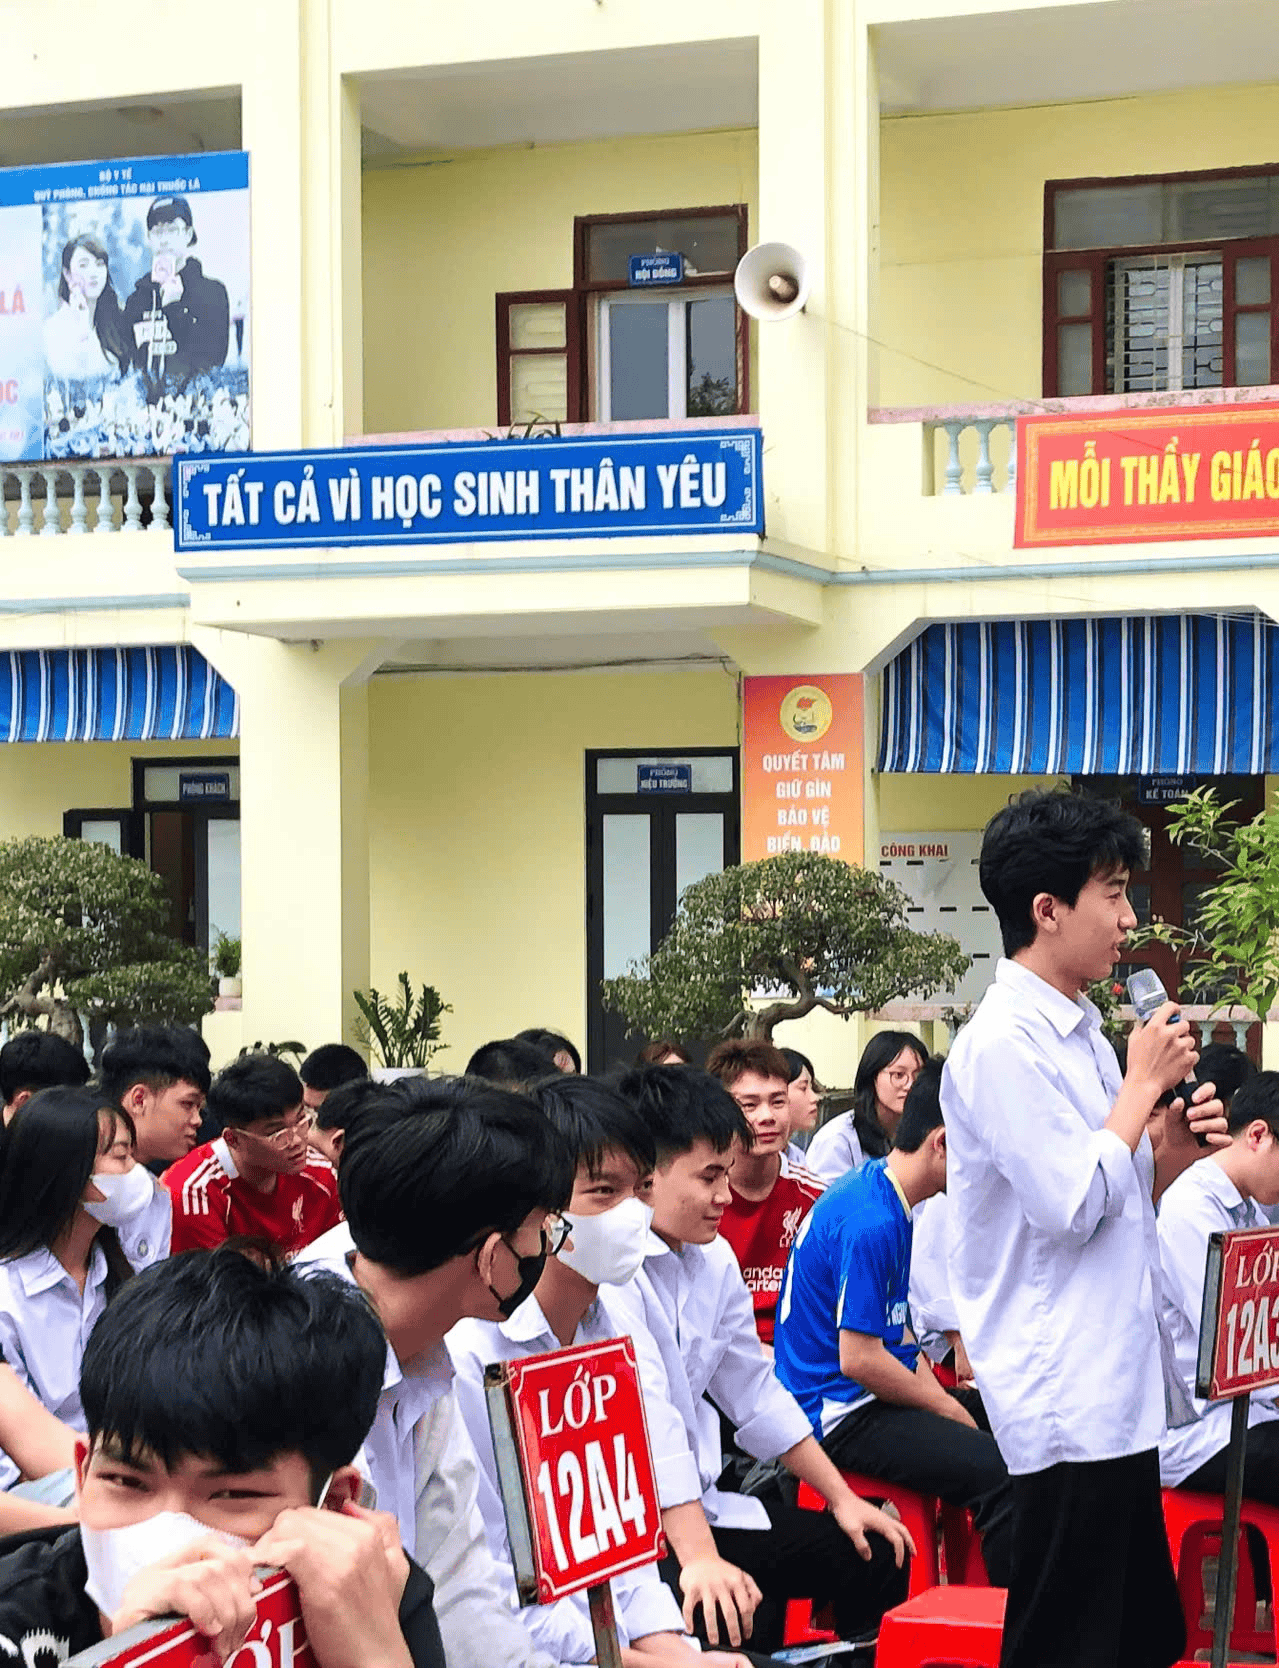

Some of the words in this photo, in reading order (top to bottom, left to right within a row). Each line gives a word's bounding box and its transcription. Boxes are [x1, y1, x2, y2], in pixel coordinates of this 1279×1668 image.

[1049, 438, 1110, 509] MỖI
[1120, 436, 1200, 505] THẦY
[204, 469, 263, 527] TẤT
[274, 466, 318, 524] CẢ
[329, 469, 361, 522] VÌ
[373, 474, 442, 528] HỌC
[454, 470, 539, 516] SINH
[550, 457, 646, 513] THÂN
[658, 453, 727, 508] YÊU
[763, 749, 808, 772] QUYẾT
[812, 751, 845, 771] TÂM
[776, 778, 803, 799] GIỮ
[805, 777, 832, 799] GÌN
[1146, 787, 1159, 799] KẾ
[777, 805, 808, 826] BẢO
[811, 804, 830, 831] VỆ
[881, 842, 915, 857] CÔNG
[919, 844, 948, 857] KHAI
[743, 1264, 784, 1280] anda
[537, 1363, 617, 1439] LỚP
[537, 1433, 648, 1572] 12A4
